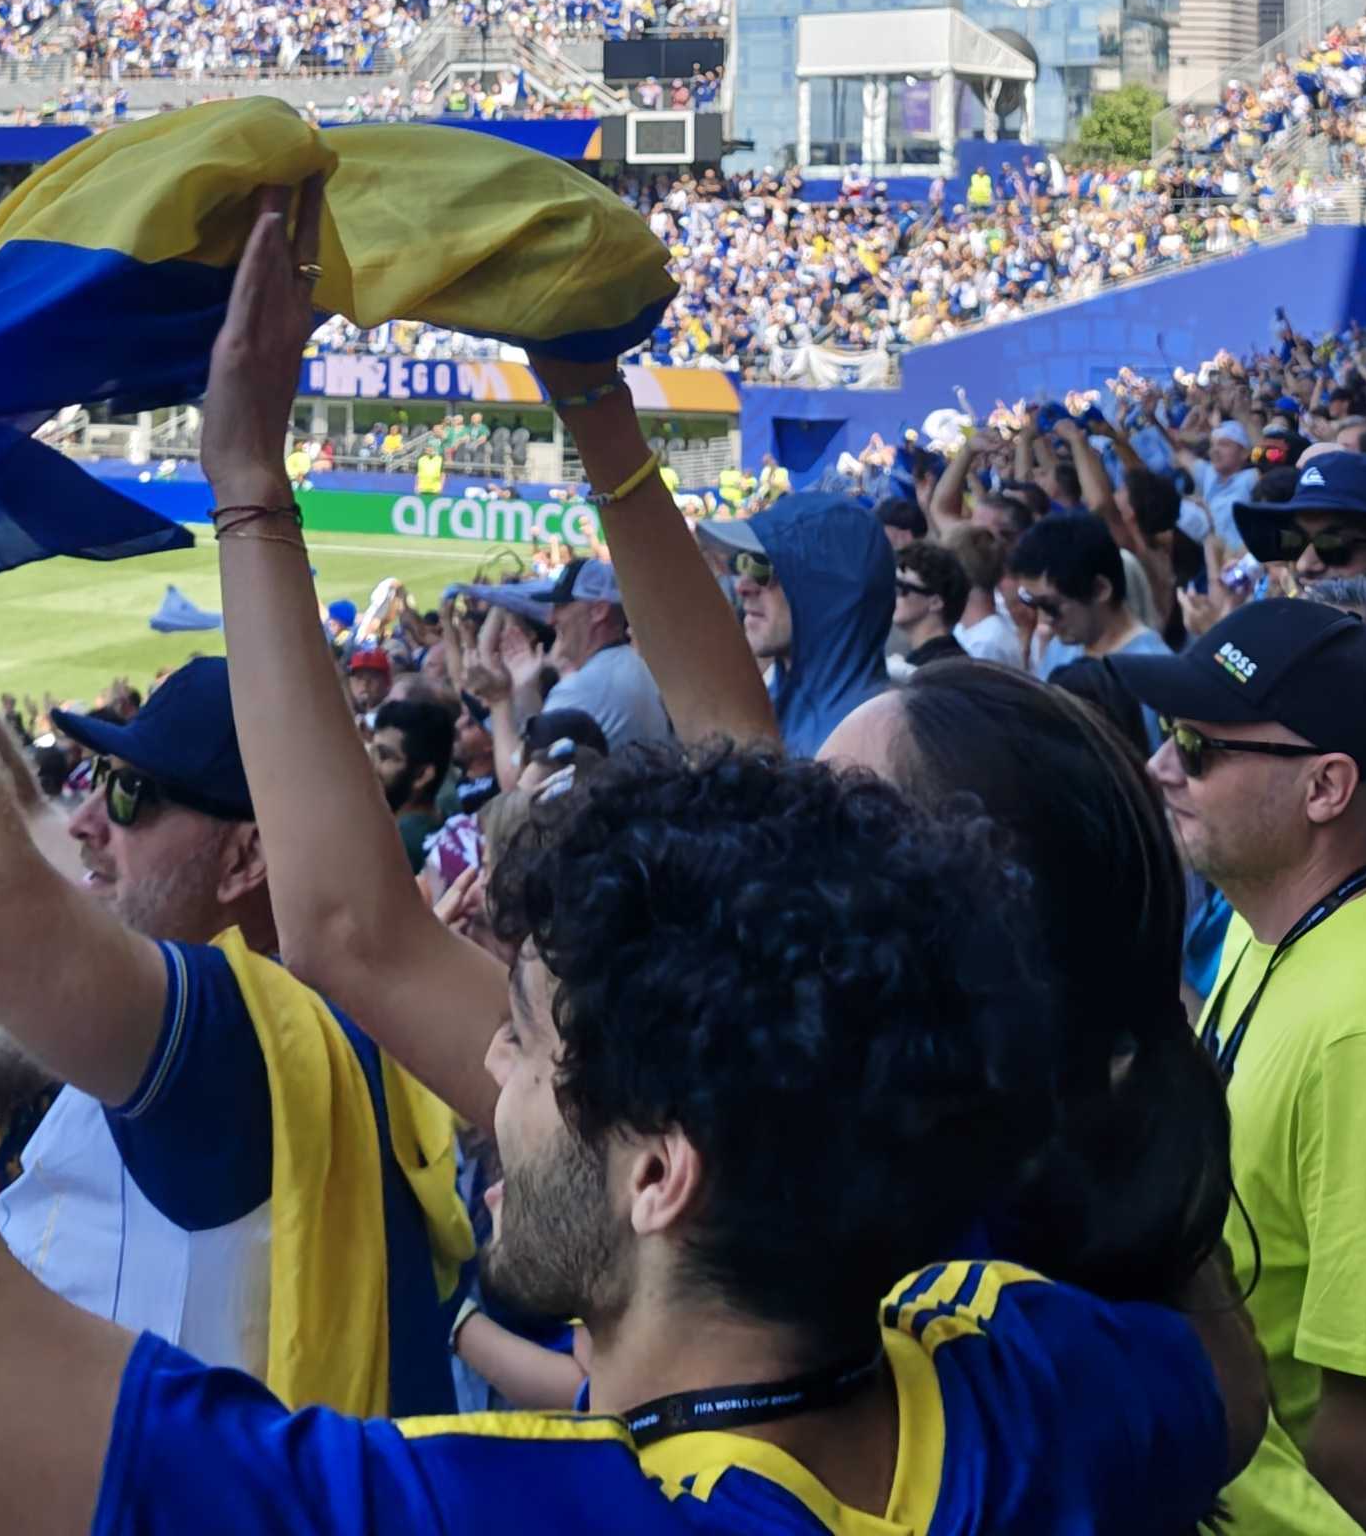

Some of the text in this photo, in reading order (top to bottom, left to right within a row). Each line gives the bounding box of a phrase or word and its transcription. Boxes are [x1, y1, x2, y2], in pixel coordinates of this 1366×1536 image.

[392, 495, 599, 546] aramco
[1219, 641, 1257, 677] BOSS
[693, 1401, 715, 1415] FIFA
[715, 1398, 750, 1411] WORLD
